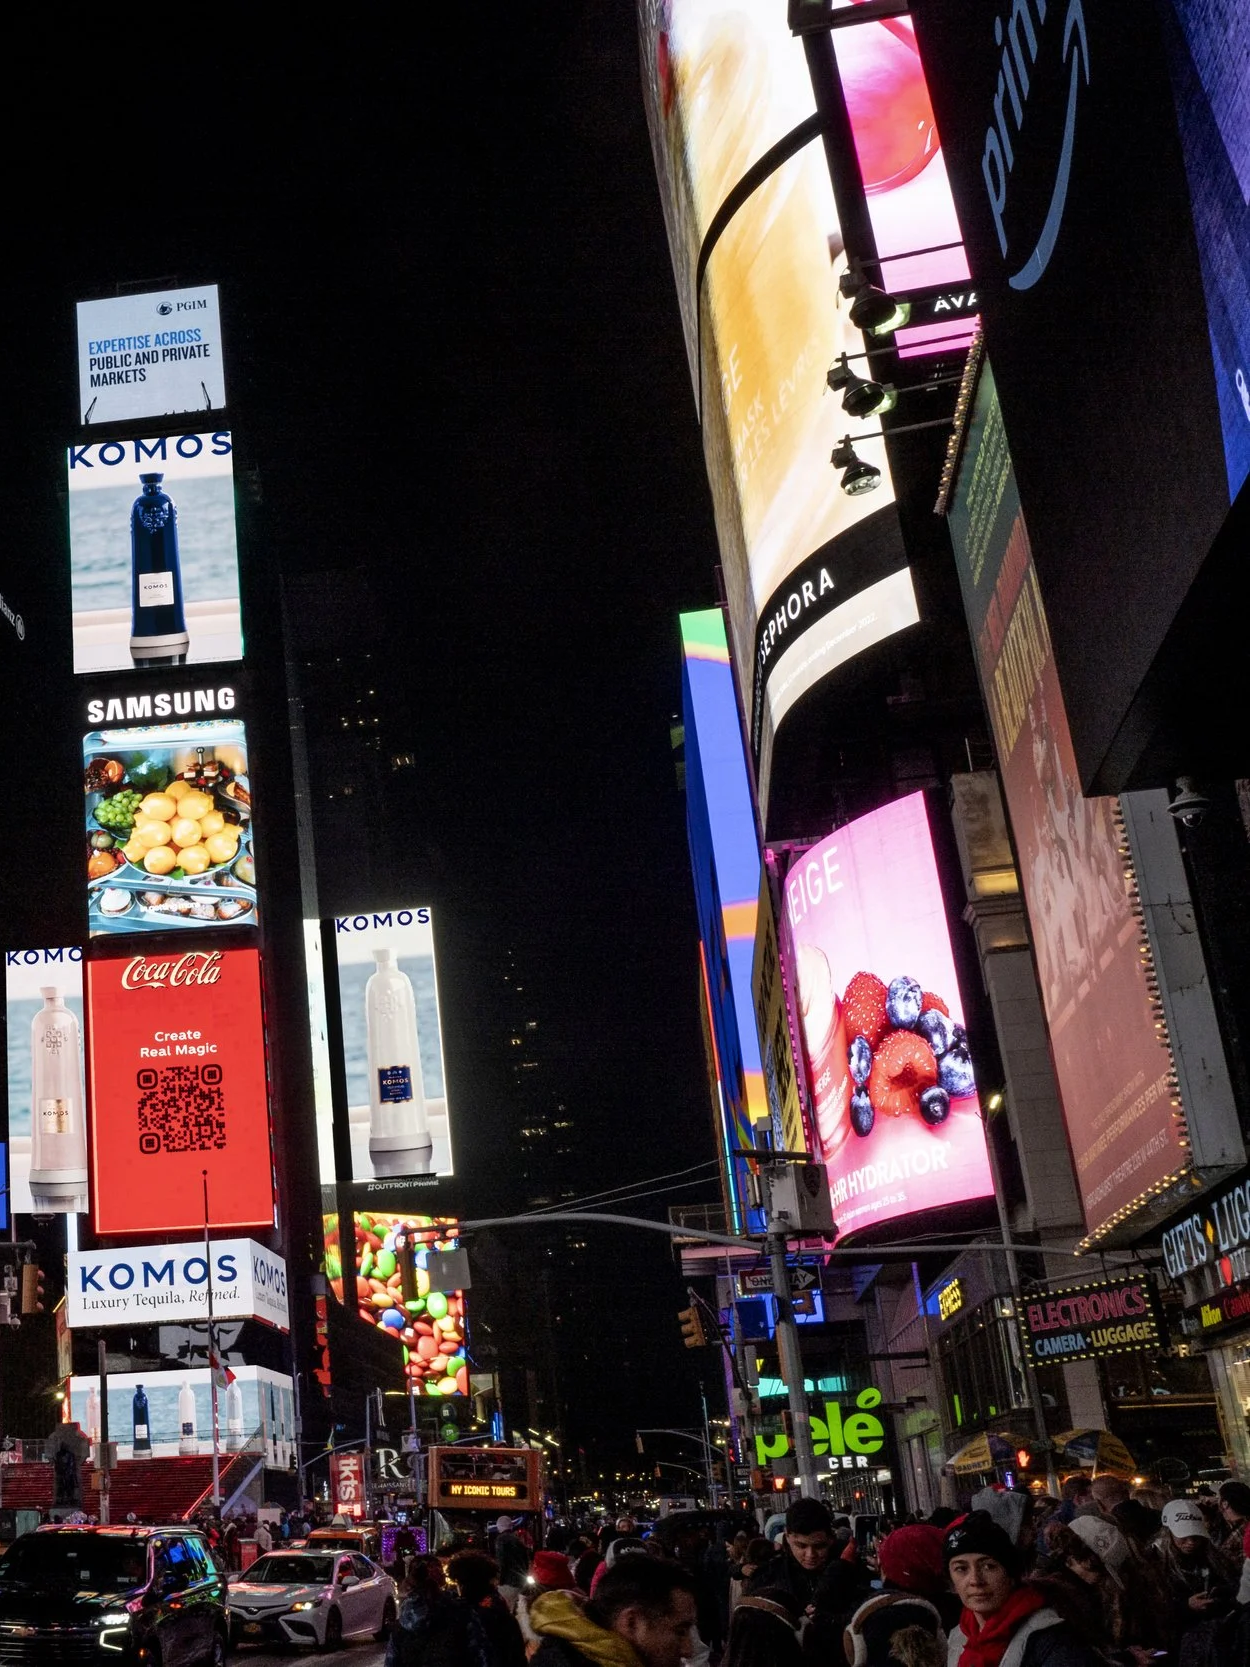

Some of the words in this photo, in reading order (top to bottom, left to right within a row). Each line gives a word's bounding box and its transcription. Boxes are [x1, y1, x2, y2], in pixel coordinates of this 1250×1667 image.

[176, 299, 207, 312] PGIM
[88, 335, 151, 355] EXPERTISE
[154, 328, 202, 347] ACROSS
[89, 354, 132, 372] PUBLIC
[134, 350, 159, 366] AND
[162, 344, 211, 362] PRIVATE
[90, 368, 147, 388] MARKETS
[69, 431, 233, 469] KOMOS
[143, 583, 168, 591] KOMOS
[759, 567, 835, 665] SEPHORA
[87, 687, 236, 723] SAMSUNG
[787, 846, 845, 929] EIGE
[336, 907, 431, 933] KOMOS
[121, 950, 225, 990] Coca-Cola
[140, 1044, 172, 1059] Real
[175, 1040, 218, 1058] Magic
[154, 1029, 202, 1043] Create
[381, 1075, 410, 1086] KOMOS
[848, 1145, 949, 1197] HYDRATOR
[1162, 1212, 1207, 1279] GIFTS
[80, 1254, 238, 1293] KOMOS
[253, 1255, 287, 1297] KOMOS
[83, 1296, 130, 1312] Luxury
[133, 1290, 185, 1308] Tequila,
[1027, 1285, 1146, 1332] ELECTRONICS
[1035, 1332, 1087, 1357] CAMERA
[1091, 1321, 1151, 1348] LUGGAGE
[337, 1456, 359, 1501] tkts
[828, 1455, 869, 1470] CER
[451, 1485, 462, 1495] NY
[463, 1484, 490, 1495] ICONIC
[492, 1486, 516, 1496] TOURS
